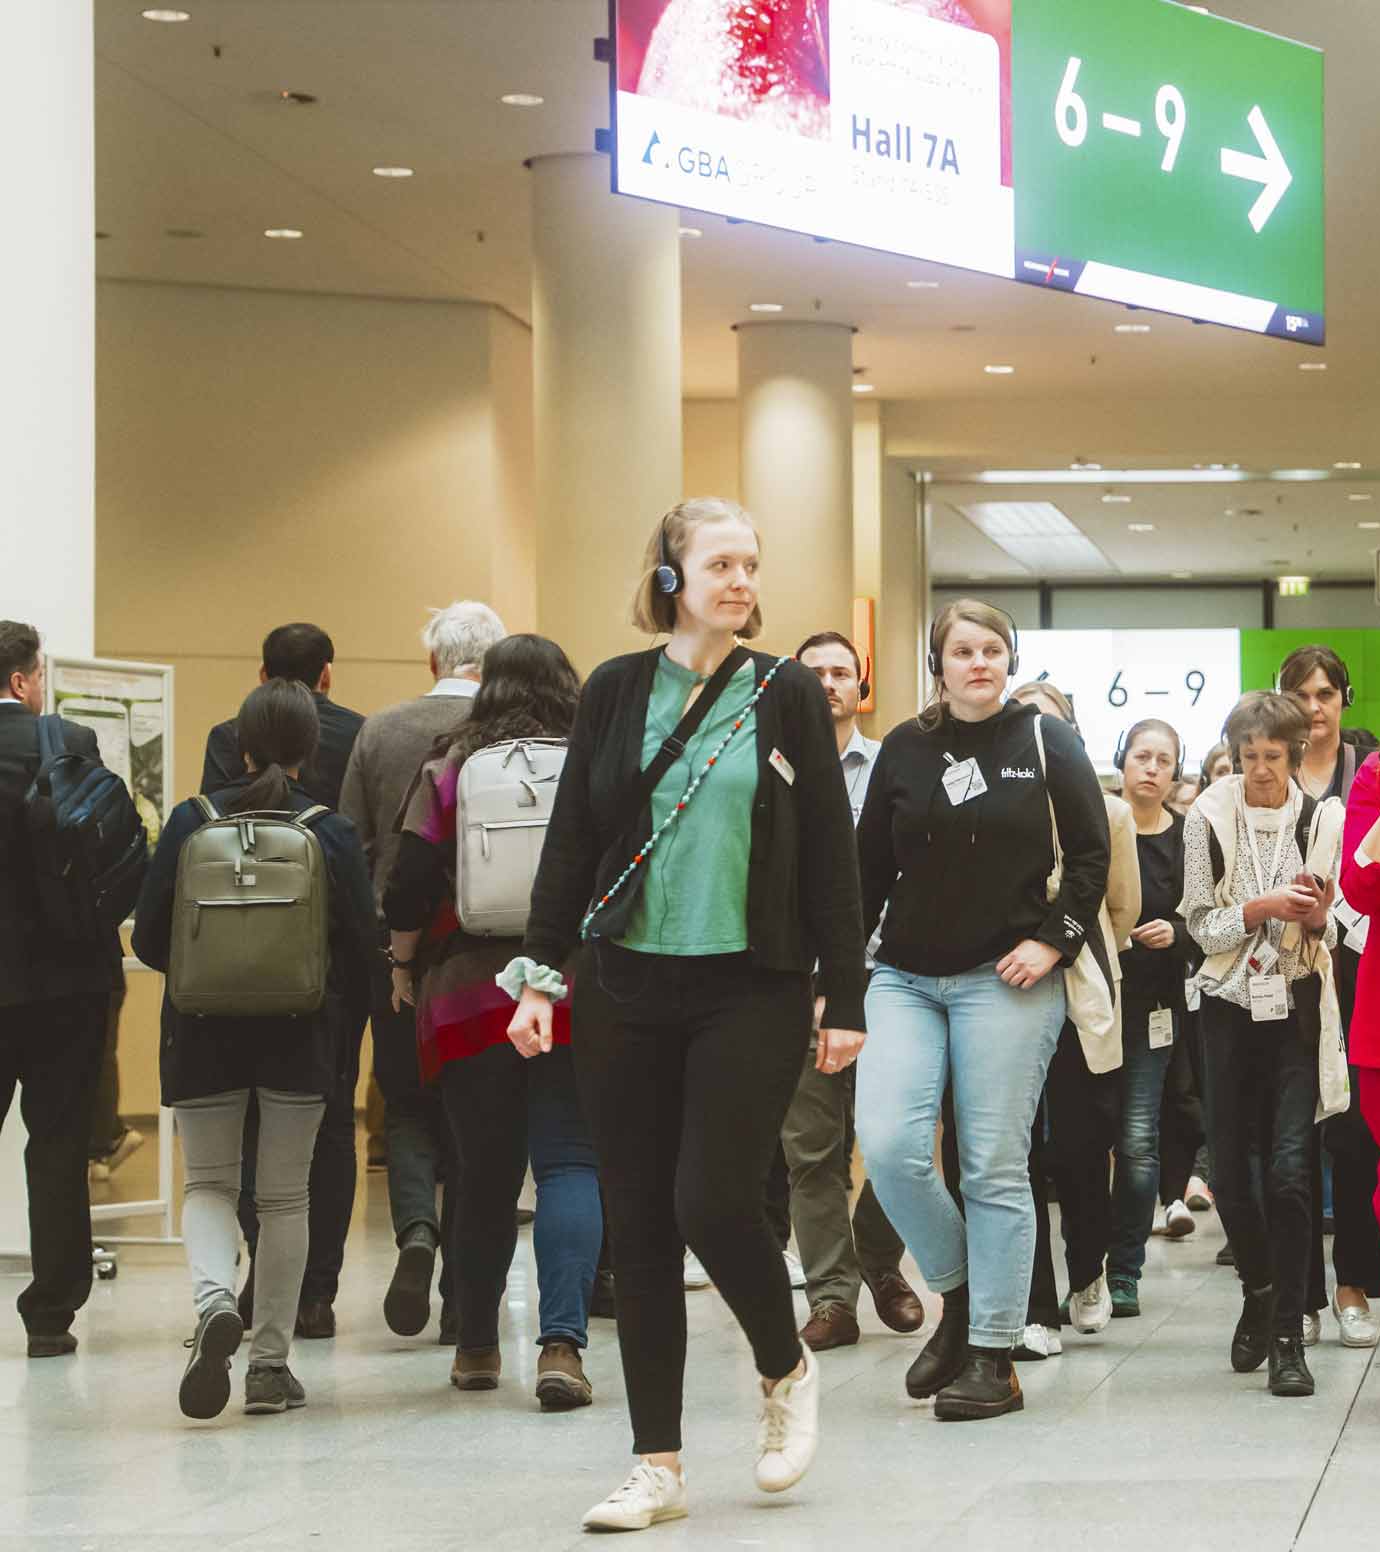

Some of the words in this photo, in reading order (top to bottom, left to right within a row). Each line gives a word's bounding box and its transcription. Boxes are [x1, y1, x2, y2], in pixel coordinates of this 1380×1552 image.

[1055, 56, 1088, 147] 6
[1155, 83, 1186, 172] 9
[678, 146, 731, 183] GBA
[851, 113, 912, 164] Hall
[923, 132, 961, 175] 7A
[1108, 670, 1128, 707] 6
[1186, 670, 1206, 707] 9
